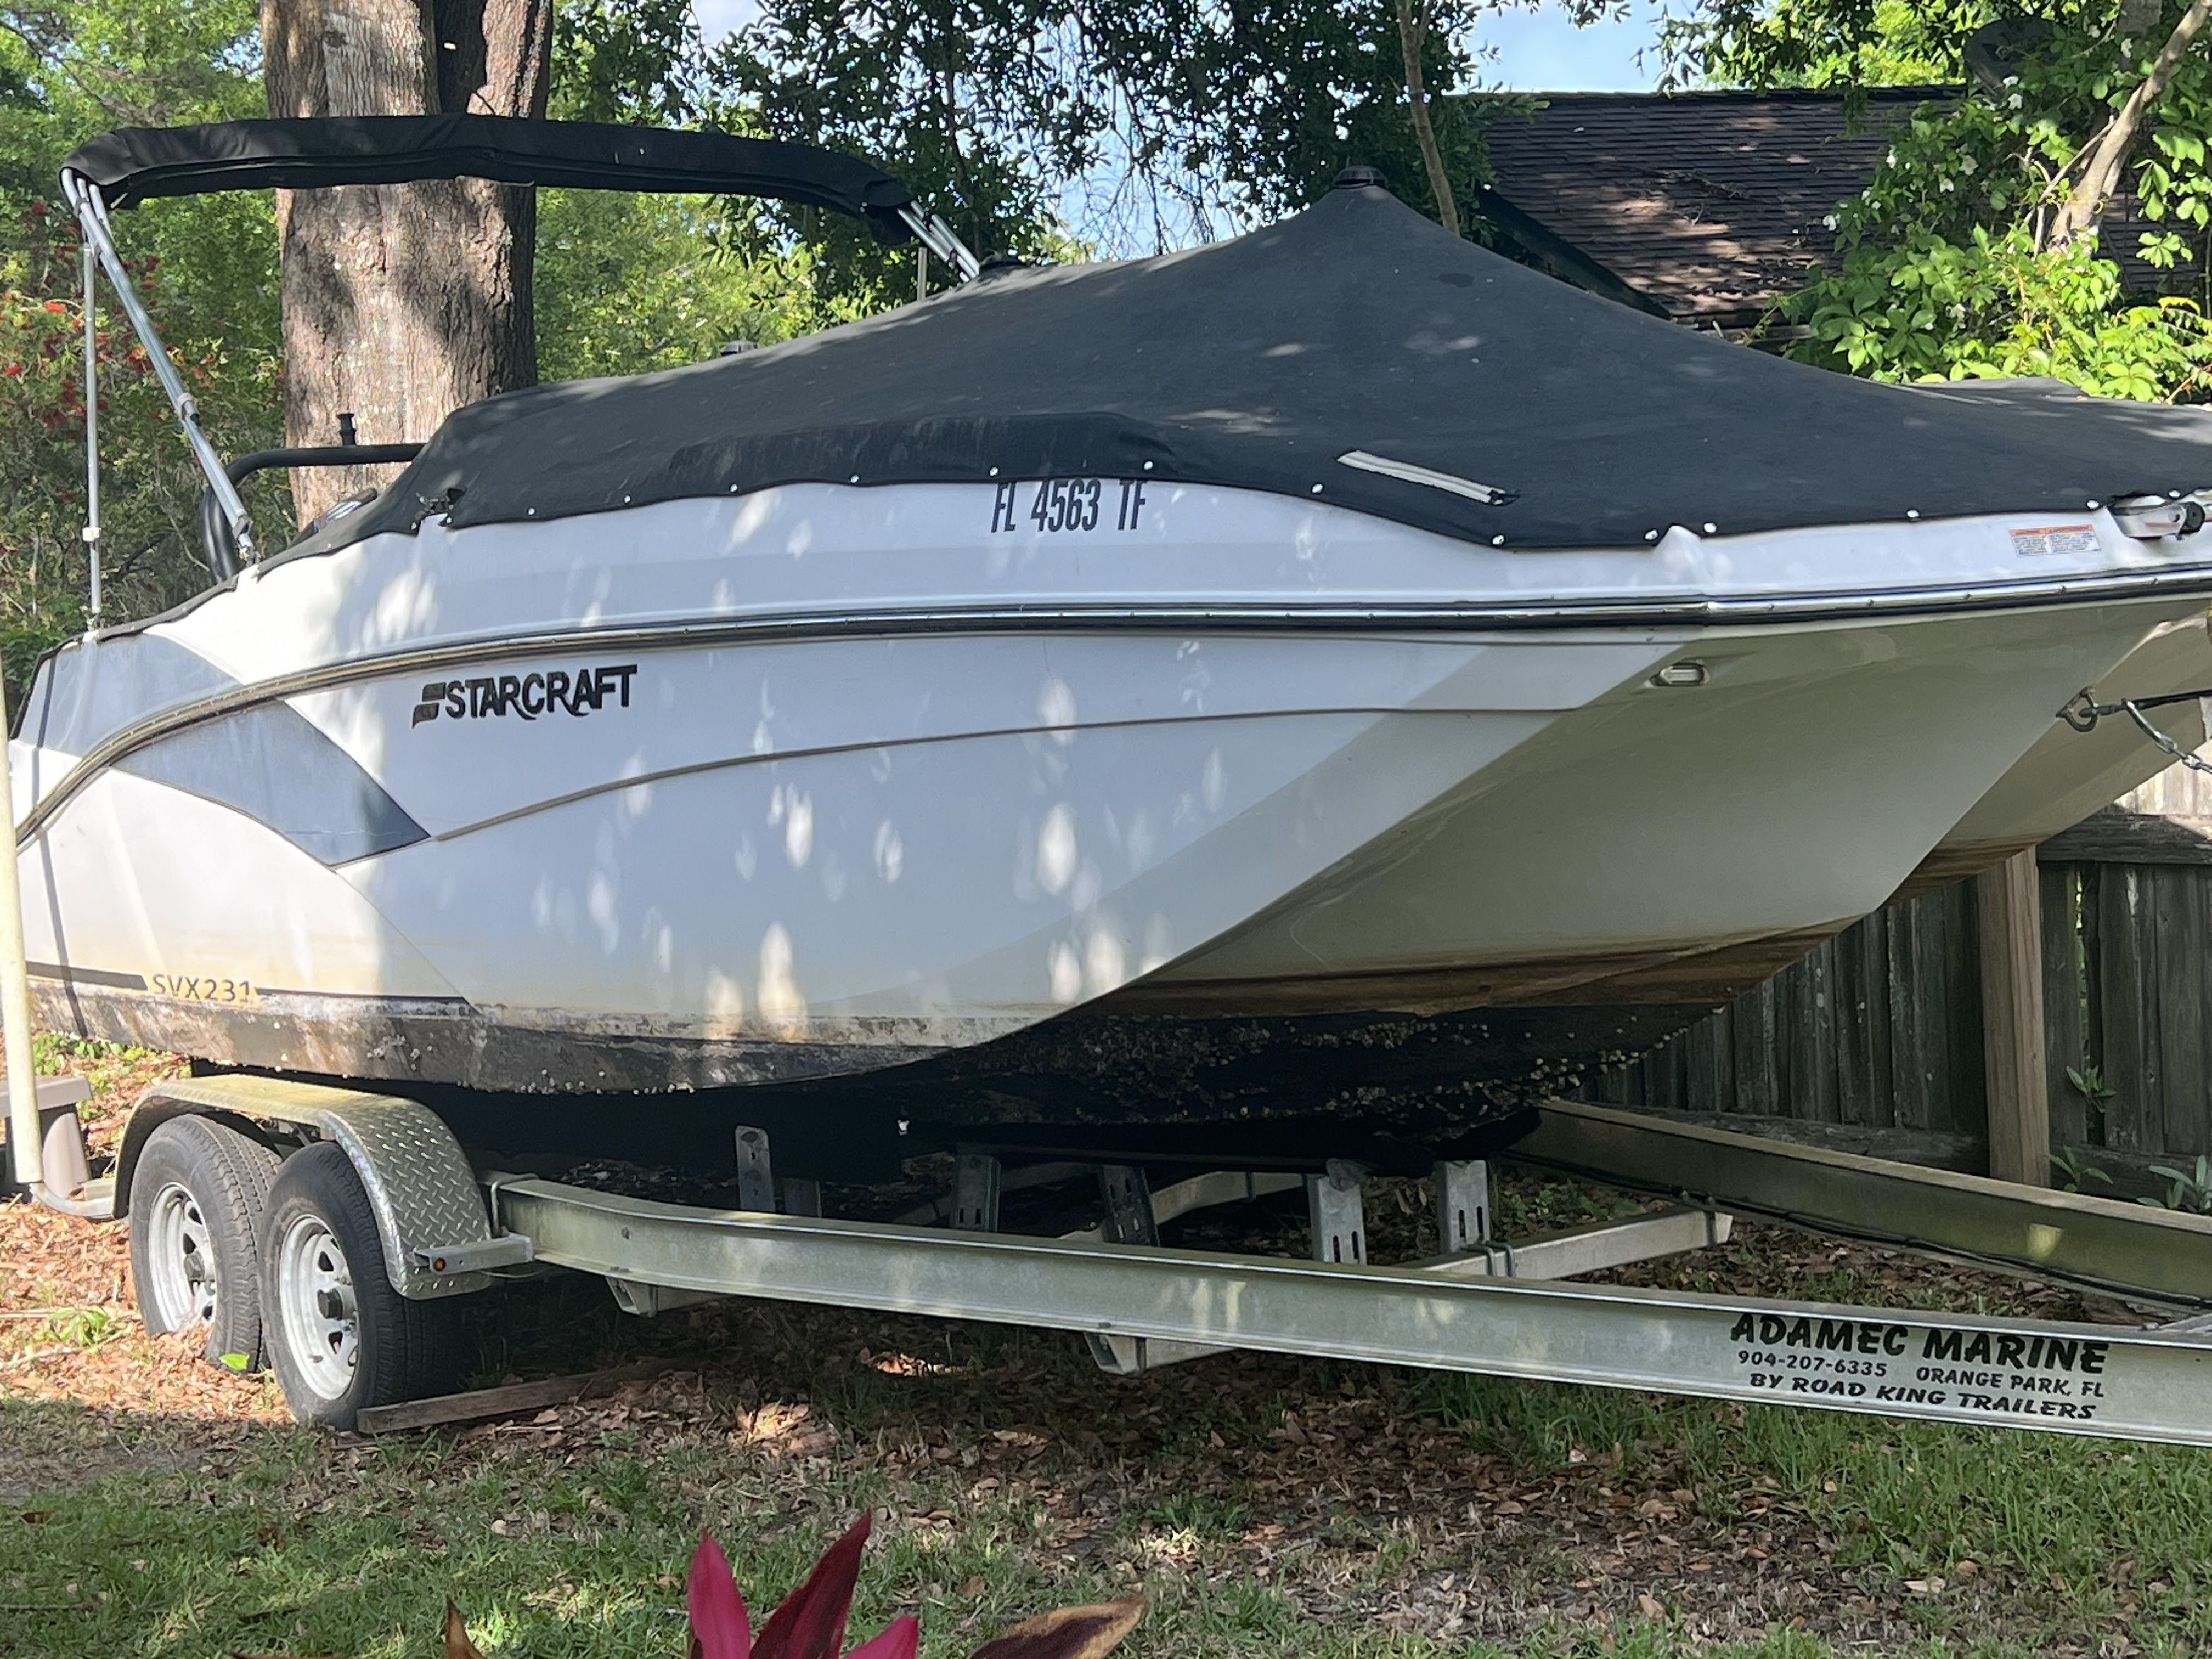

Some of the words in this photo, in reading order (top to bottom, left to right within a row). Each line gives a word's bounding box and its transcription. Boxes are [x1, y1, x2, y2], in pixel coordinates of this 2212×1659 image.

[991, 482, 1017, 533] FL
[1030, 478, 1101, 532] 4563
[1118, 480, 1149, 531] TF
[445, 664, 638, 720] STARCRAFT
[153, 974, 251, 1003] SVX231
[1730, 1313, 1908, 1356] ADAMEC
[1922, 1329, 2109, 1374] MARINE
[1738, 1350, 1887, 1377] 904-207-6335
[1916, 1367, 2004, 1389] ORANGE
[2081, 1381, 2104, 1398] FL
[1750, 1373, 1784, 1389] BY
[1791, 1376, 1866, 1397] ROAD
[1876, 1385, 1946, 1404] KING
[1957, 1392, 2097, 1420] TRAILERS
